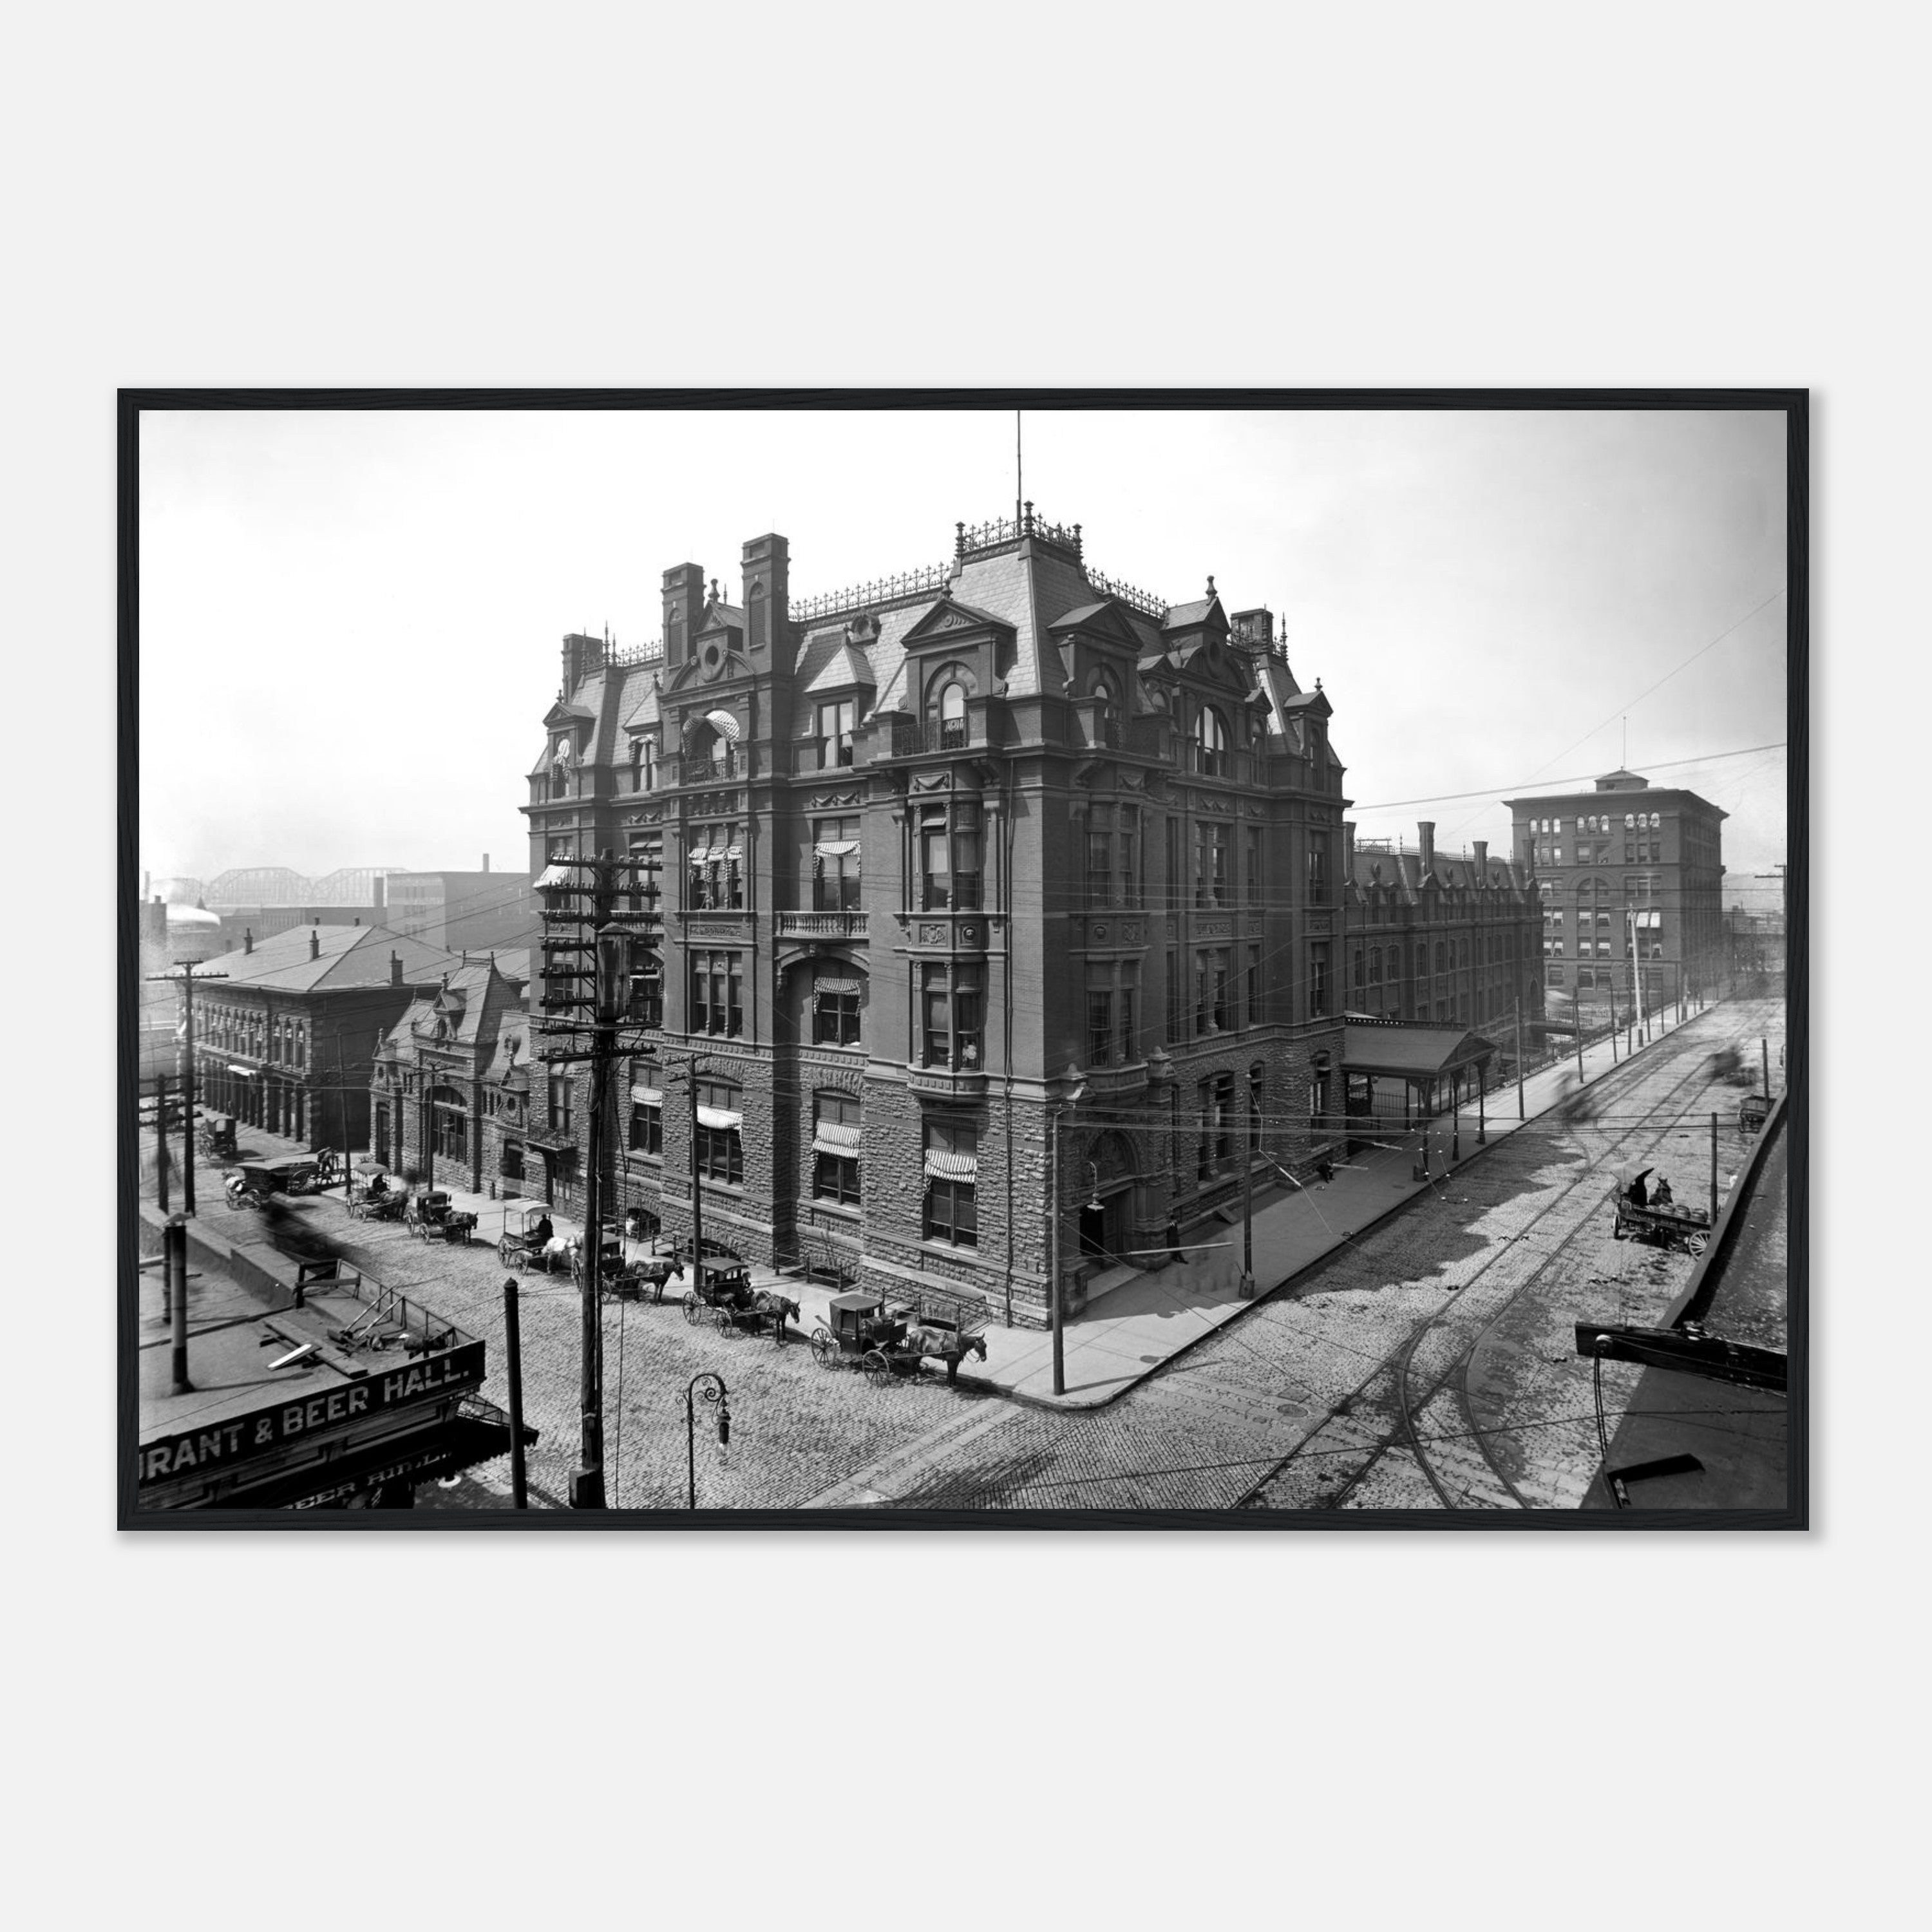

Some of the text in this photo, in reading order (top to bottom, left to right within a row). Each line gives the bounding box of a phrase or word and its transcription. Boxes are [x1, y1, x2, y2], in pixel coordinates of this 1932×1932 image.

[254, 1417, 273, 1444] &
[283, 1386, 369, 1436] BEER
[384, 1358, 469, 1403] HALL.
